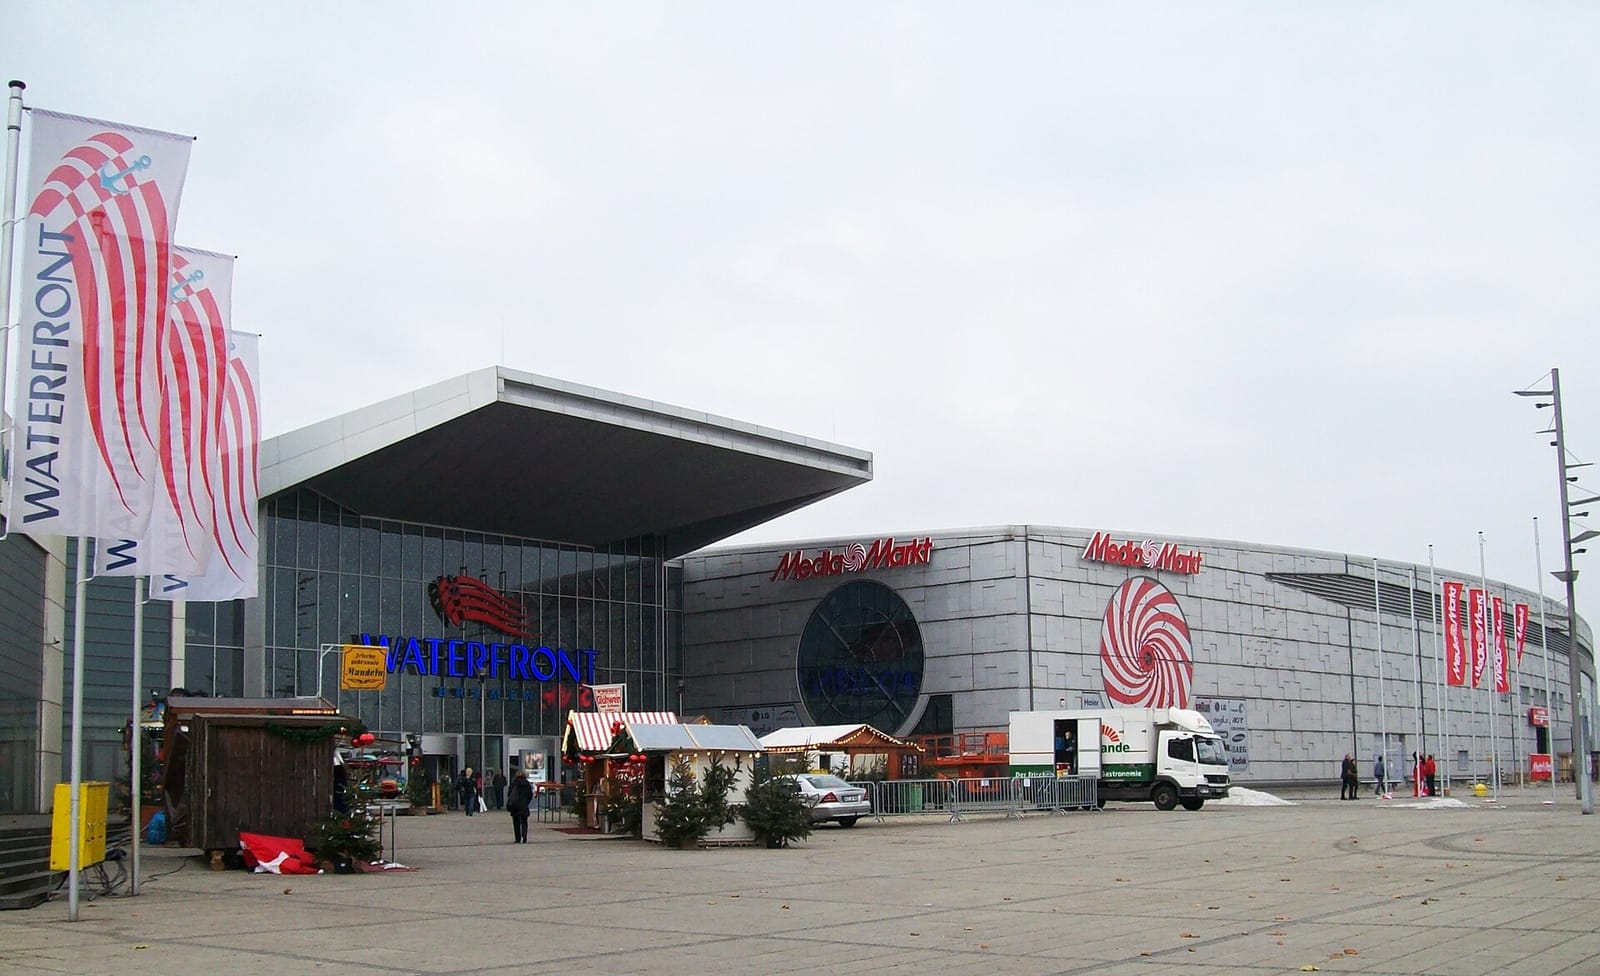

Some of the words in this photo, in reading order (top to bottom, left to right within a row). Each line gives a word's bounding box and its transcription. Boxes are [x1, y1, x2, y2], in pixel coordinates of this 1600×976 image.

[23, 222, 75, 523] WATERFRONT
[770, 550, 845, 582] Media
[860, 536, 935, 571] Markt
[1081, 530, 1143, 566] Media
[1155, 541, 1202, 575] Markt
[361, 632, 602, 684] WATERFRONT
[761, 712, 770, 720] LG
